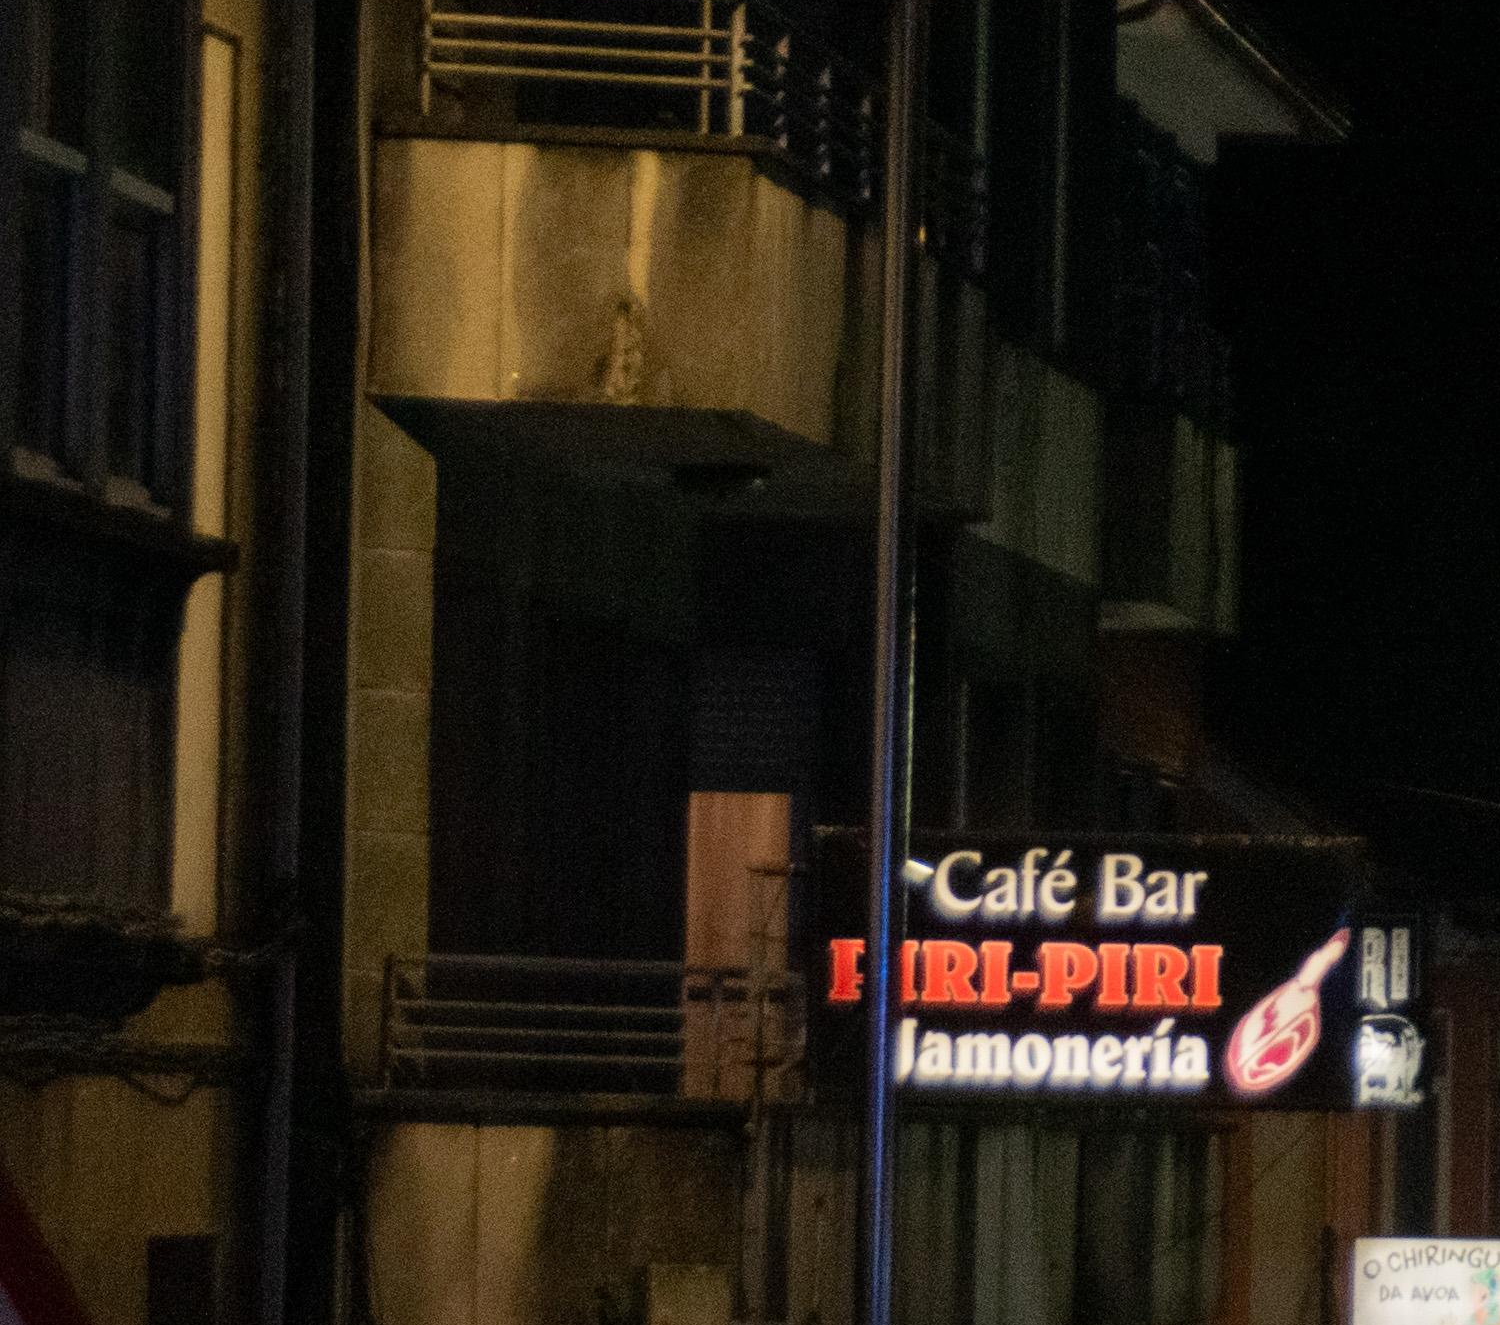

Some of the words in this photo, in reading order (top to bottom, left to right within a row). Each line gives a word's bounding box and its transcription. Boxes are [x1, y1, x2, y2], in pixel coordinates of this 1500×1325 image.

[934, 848, 1077, 916] Café
[1102, 853, 1207, 916] Bar
[896, 1018, 1209, 1084] Jamonería
[1363, 1259, 1382, 1279] O
[1379, 1285, 1402, 1302] DA
[1411, 1285, 1460, 1302] AVOA
